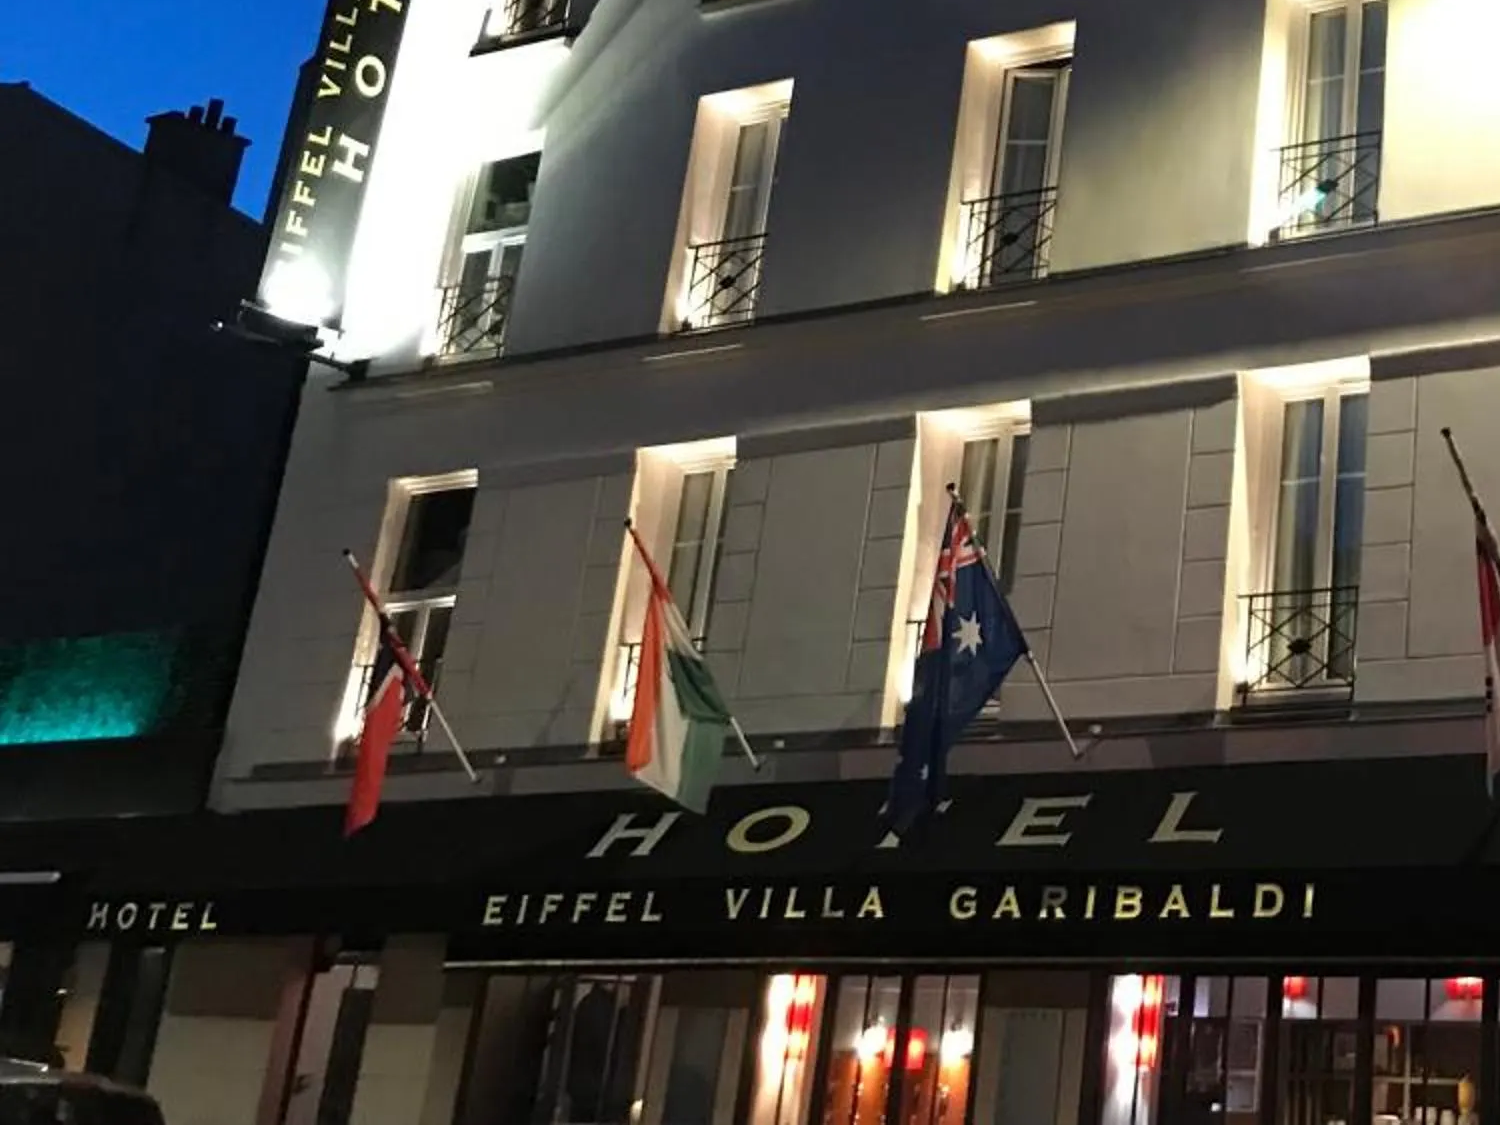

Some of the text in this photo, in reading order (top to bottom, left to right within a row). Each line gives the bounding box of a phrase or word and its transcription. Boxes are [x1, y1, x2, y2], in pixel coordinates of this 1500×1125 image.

[272, 124, 333, 278] IFFEL
[87, 901, 218, 931] HOTEL
[481, 883, 1315, 926] EIFFEL VILLA GARIBALDI
